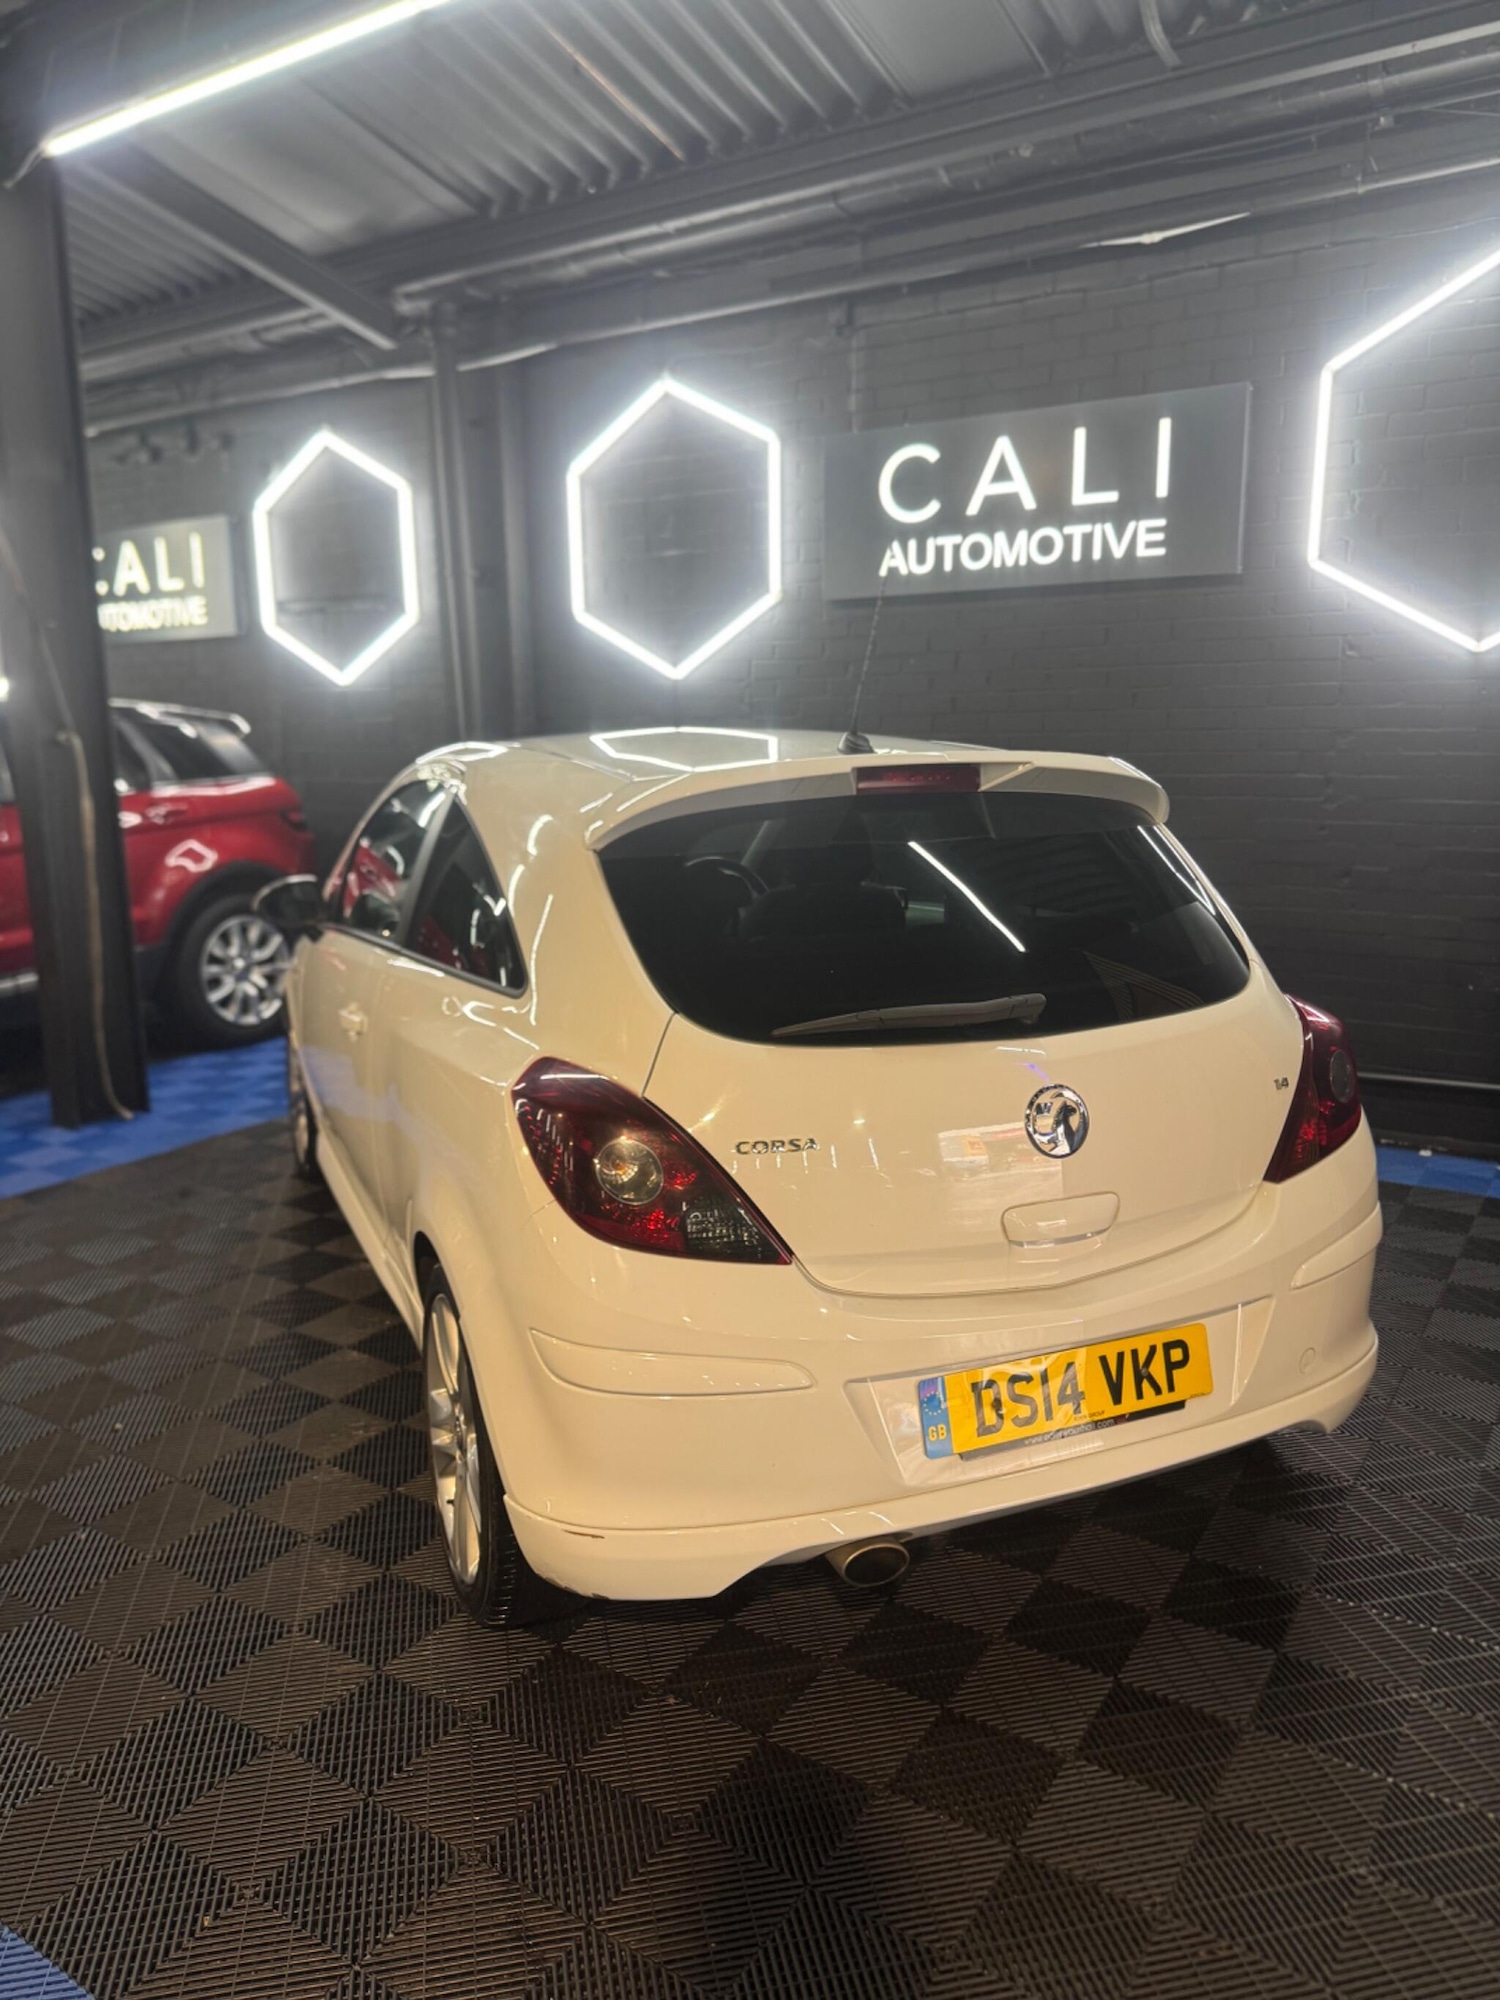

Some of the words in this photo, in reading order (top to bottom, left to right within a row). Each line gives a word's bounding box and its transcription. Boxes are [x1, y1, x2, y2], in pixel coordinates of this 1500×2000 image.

[878, 417, 1172, 524] CALI
[91, 531, 205, 597] ALI
[878, 518, 1167, 577] AUTOMOTIVE
[735, 1138, 818, 1155] CORSA
[970, 1361, 1086, 1438] DS14
[1097, 1338, 1191, 1406] VKP
[927, 1424, 948, 1442] GB
